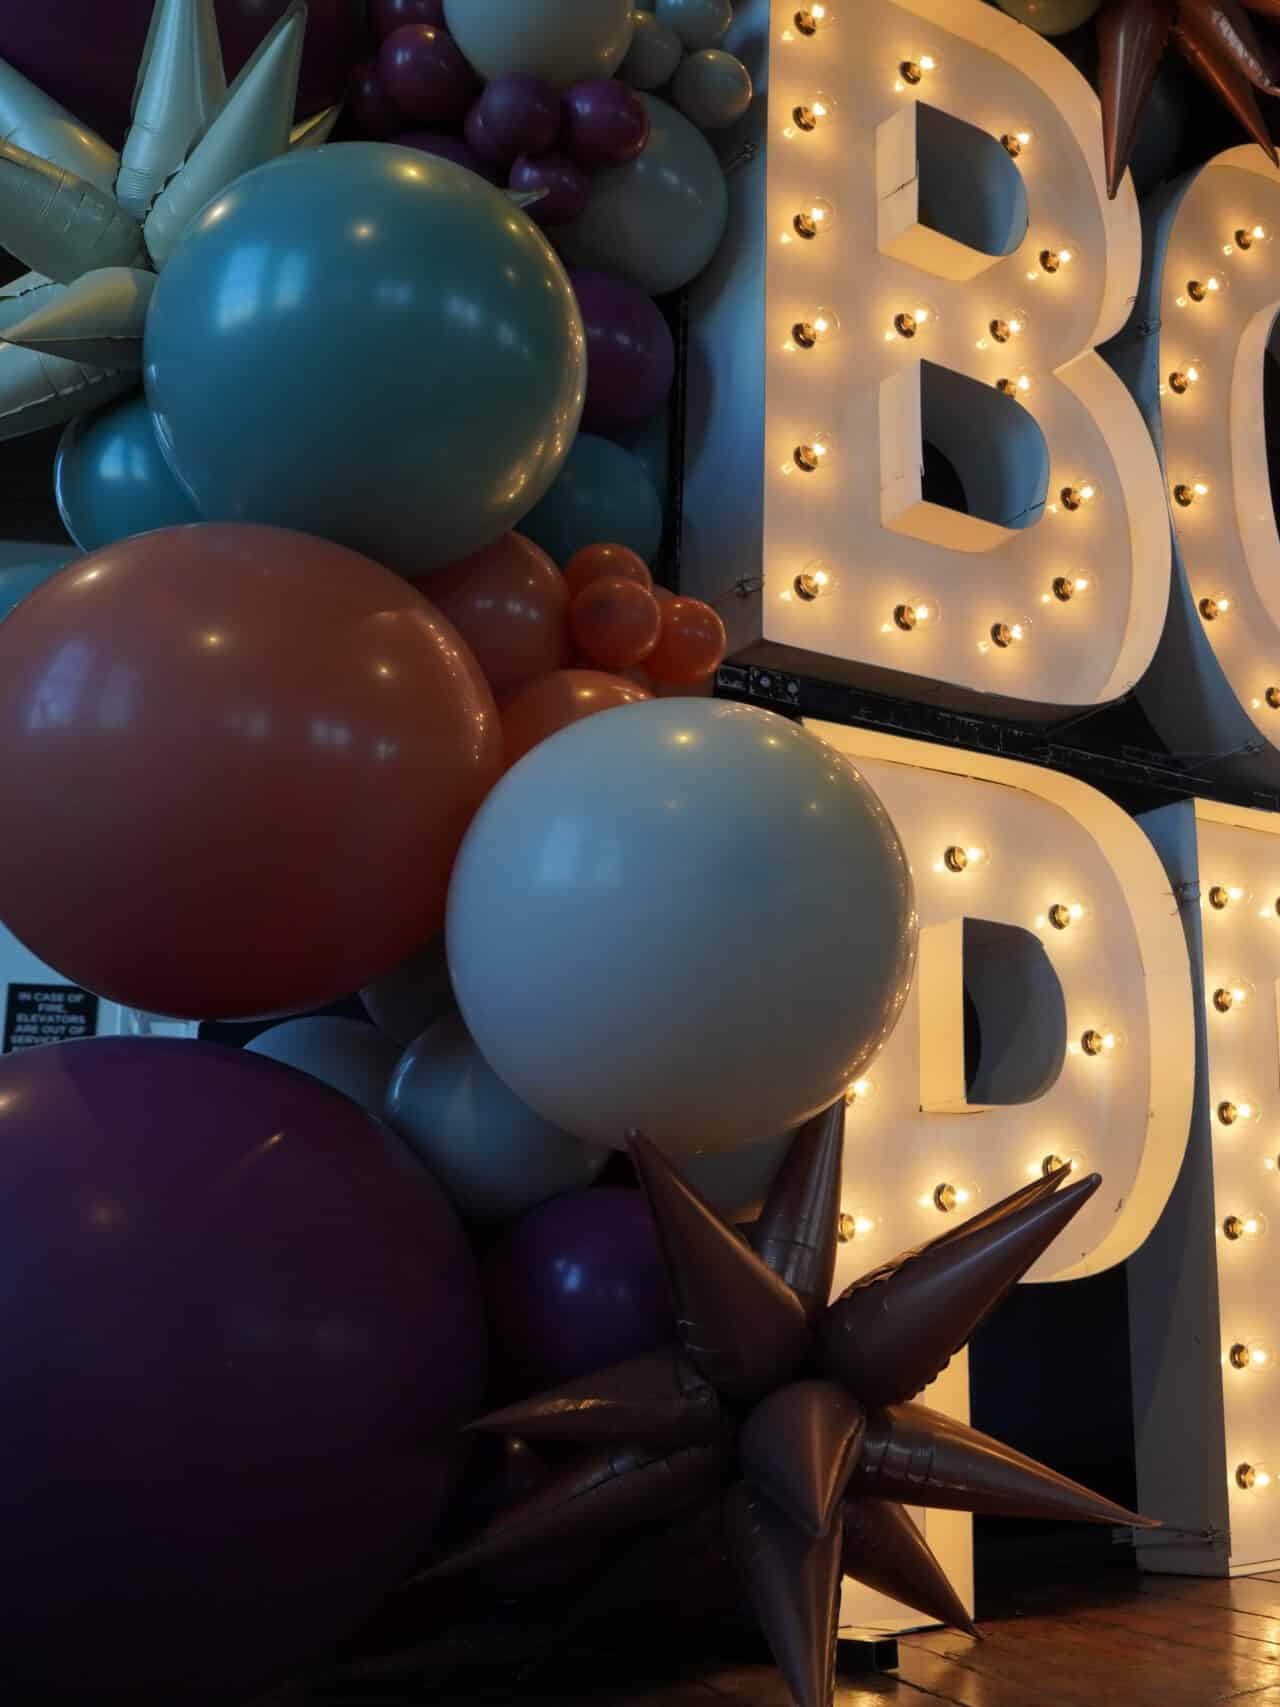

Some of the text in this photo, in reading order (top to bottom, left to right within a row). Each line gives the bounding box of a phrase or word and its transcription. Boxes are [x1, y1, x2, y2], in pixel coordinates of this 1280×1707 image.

[17, 991, 85, 1003] IN CASE OF
[16, 1013, 86, 1024] ELEVATORS
[15, 1024, 87, 1035] ARE OUT OF
